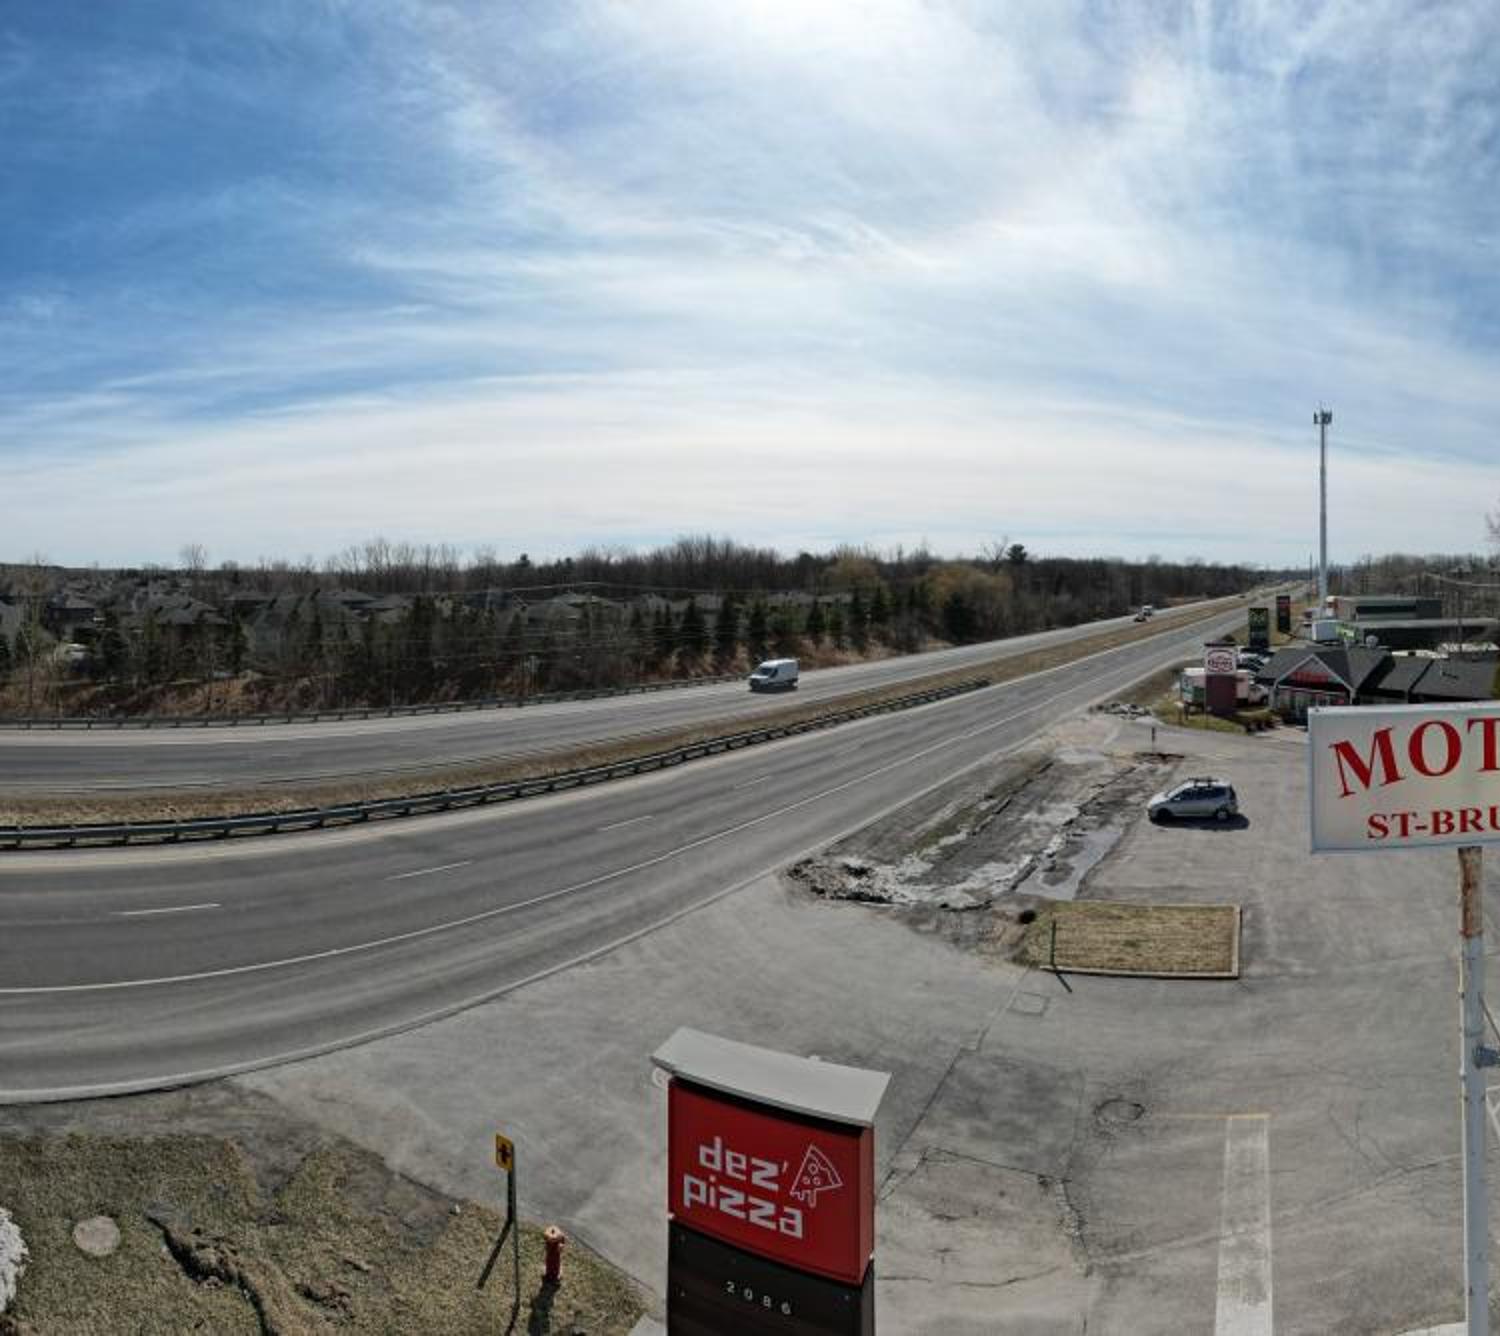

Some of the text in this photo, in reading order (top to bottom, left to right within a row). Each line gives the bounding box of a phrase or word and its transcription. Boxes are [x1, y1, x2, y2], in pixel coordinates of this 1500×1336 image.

[699, 1137, 788, 1190] dez'
[683, 1176, 804, 1239] pizza
[726, 1280, 792, 1315] 2086
